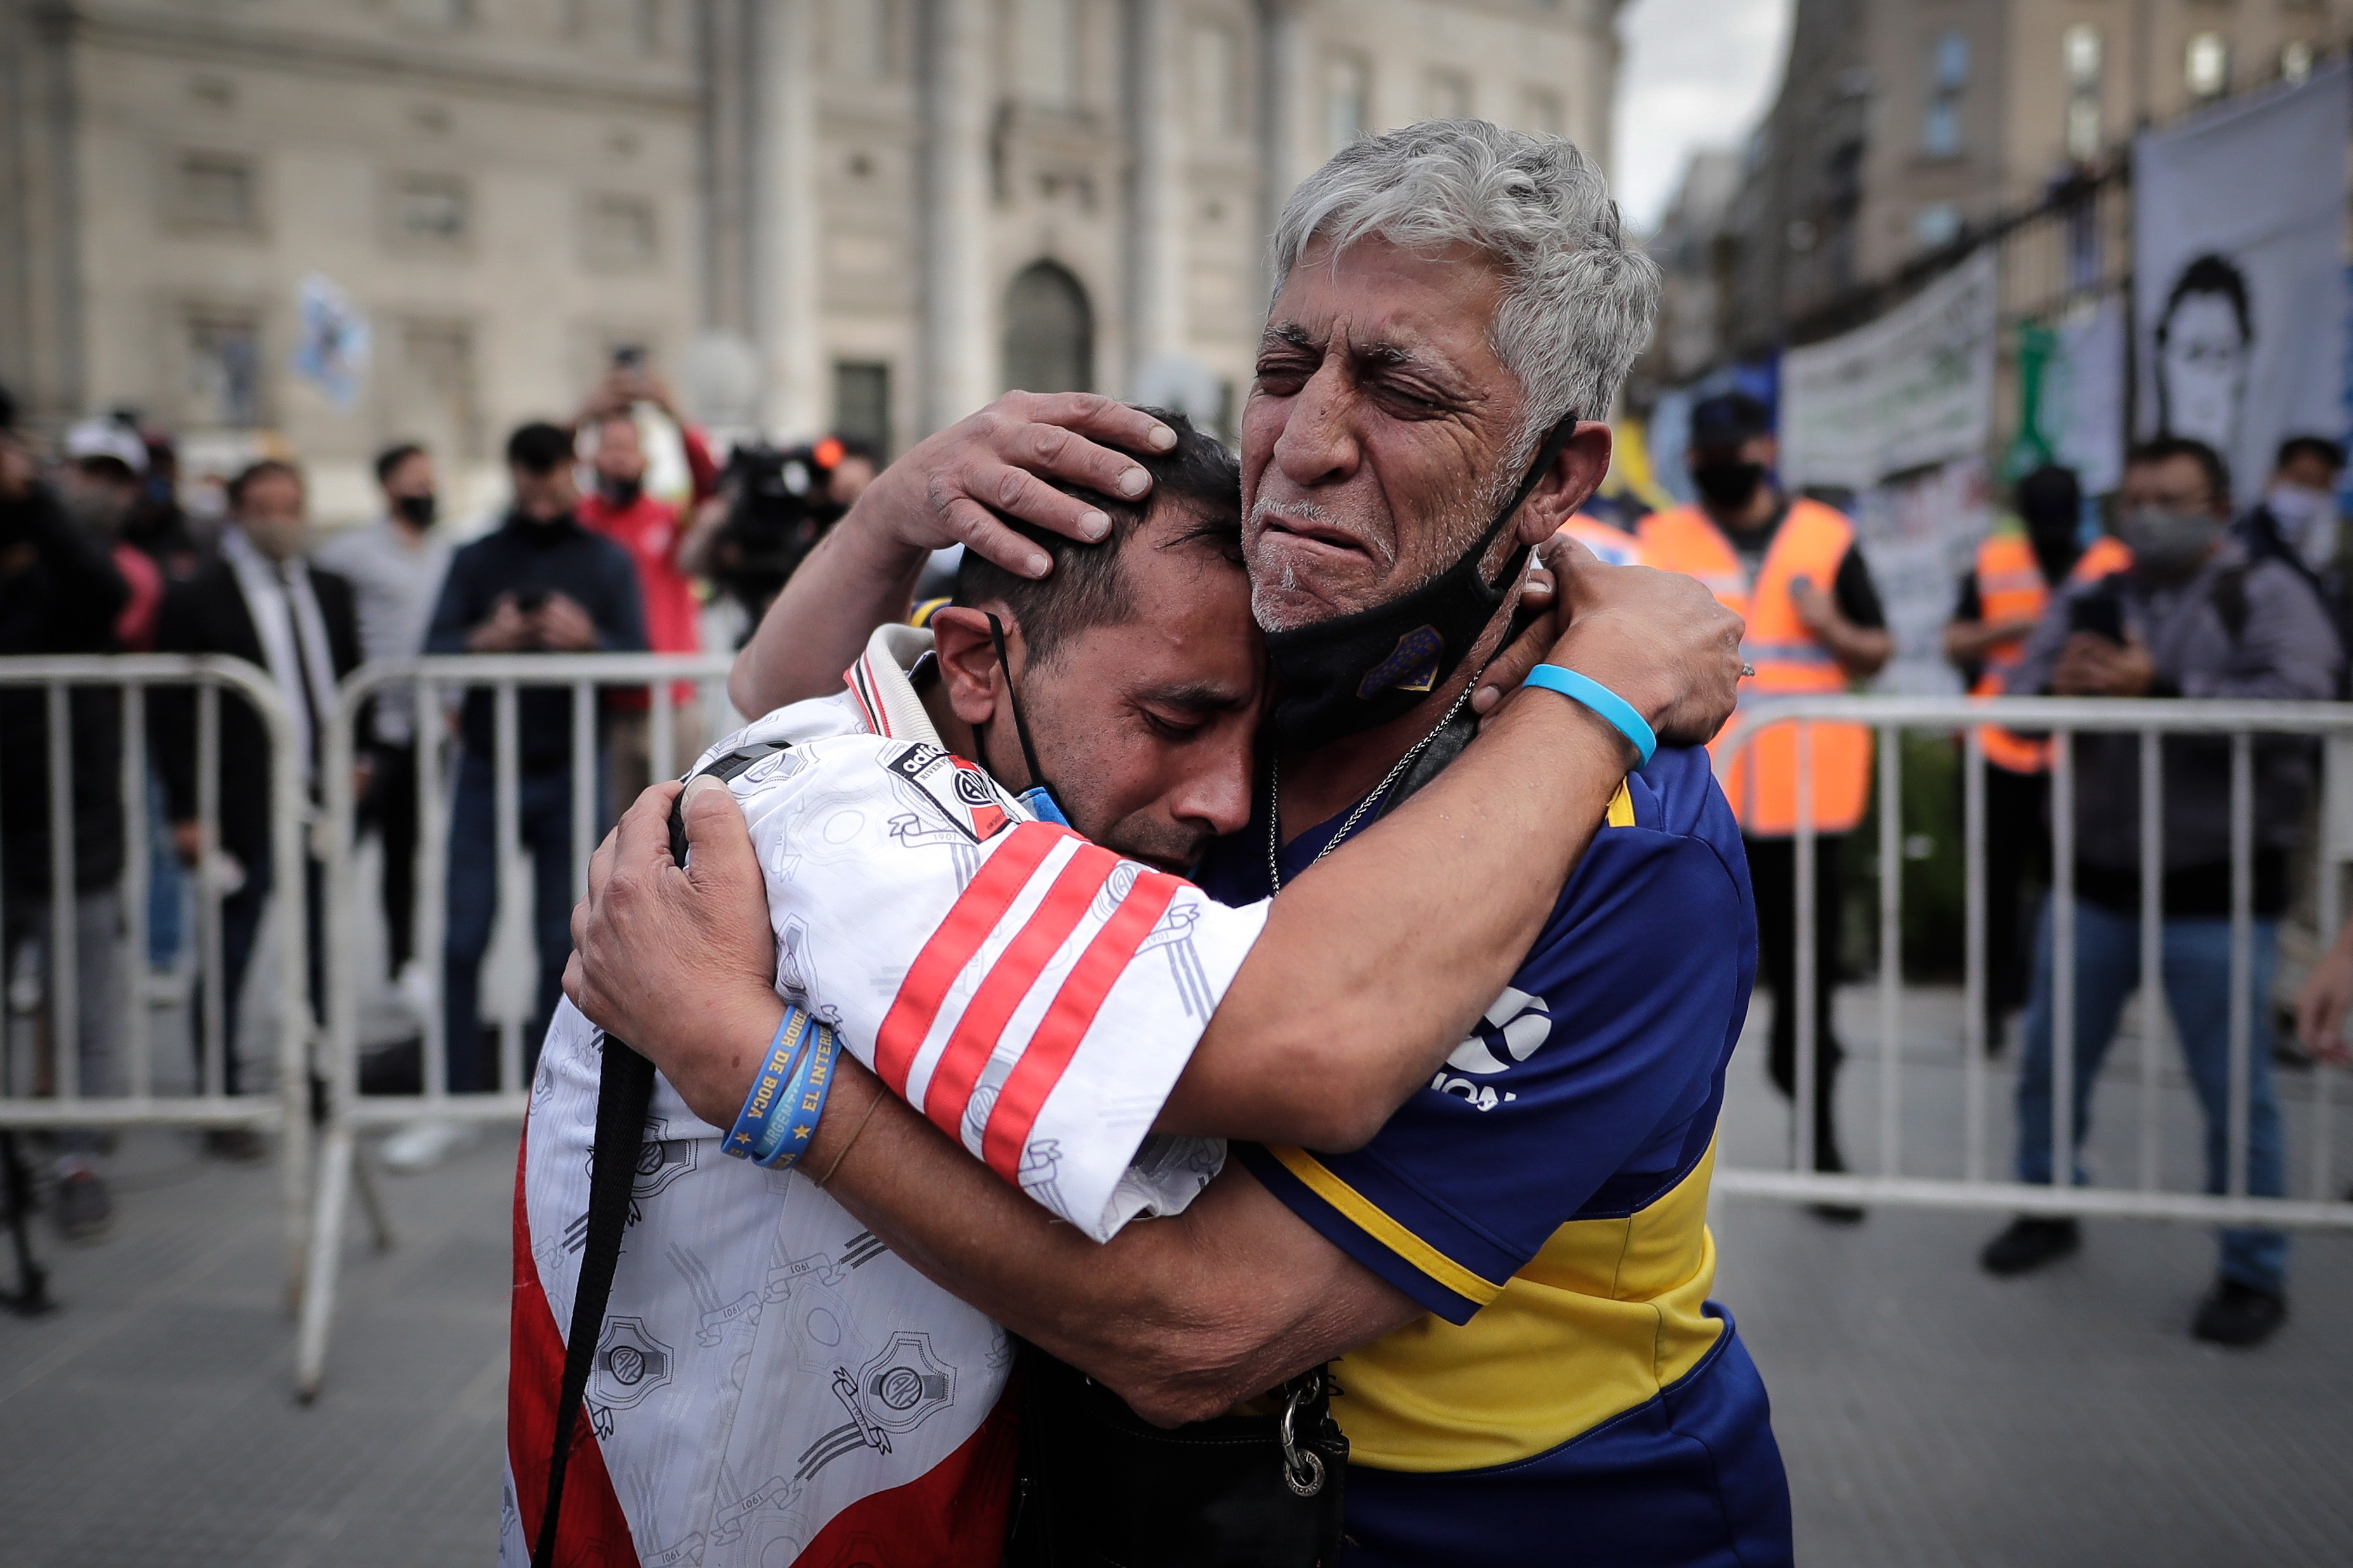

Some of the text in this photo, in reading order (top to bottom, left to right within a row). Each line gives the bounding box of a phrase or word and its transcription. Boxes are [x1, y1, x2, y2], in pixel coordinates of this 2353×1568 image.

[919, 762, 944, 781] RIVER
[933, 833, 957, 842] 1901
[1144, 931, 1169, 946] 1901
[781, 1007, 808, 1047] ERIOR
[769, 1049, 790, 1075] DE
[747, 1075, 779, 1118] BOCA
[802, 1090, 821, 1112] EL
[790, 1262, 811, 1274] 1901
[723, 1304, 741, 1319] 1901
[851, 1406, 865, 1426] 1901
[742, 1493, 763, 1510] 1901
[661, 1549, 681, 1564] 1901
